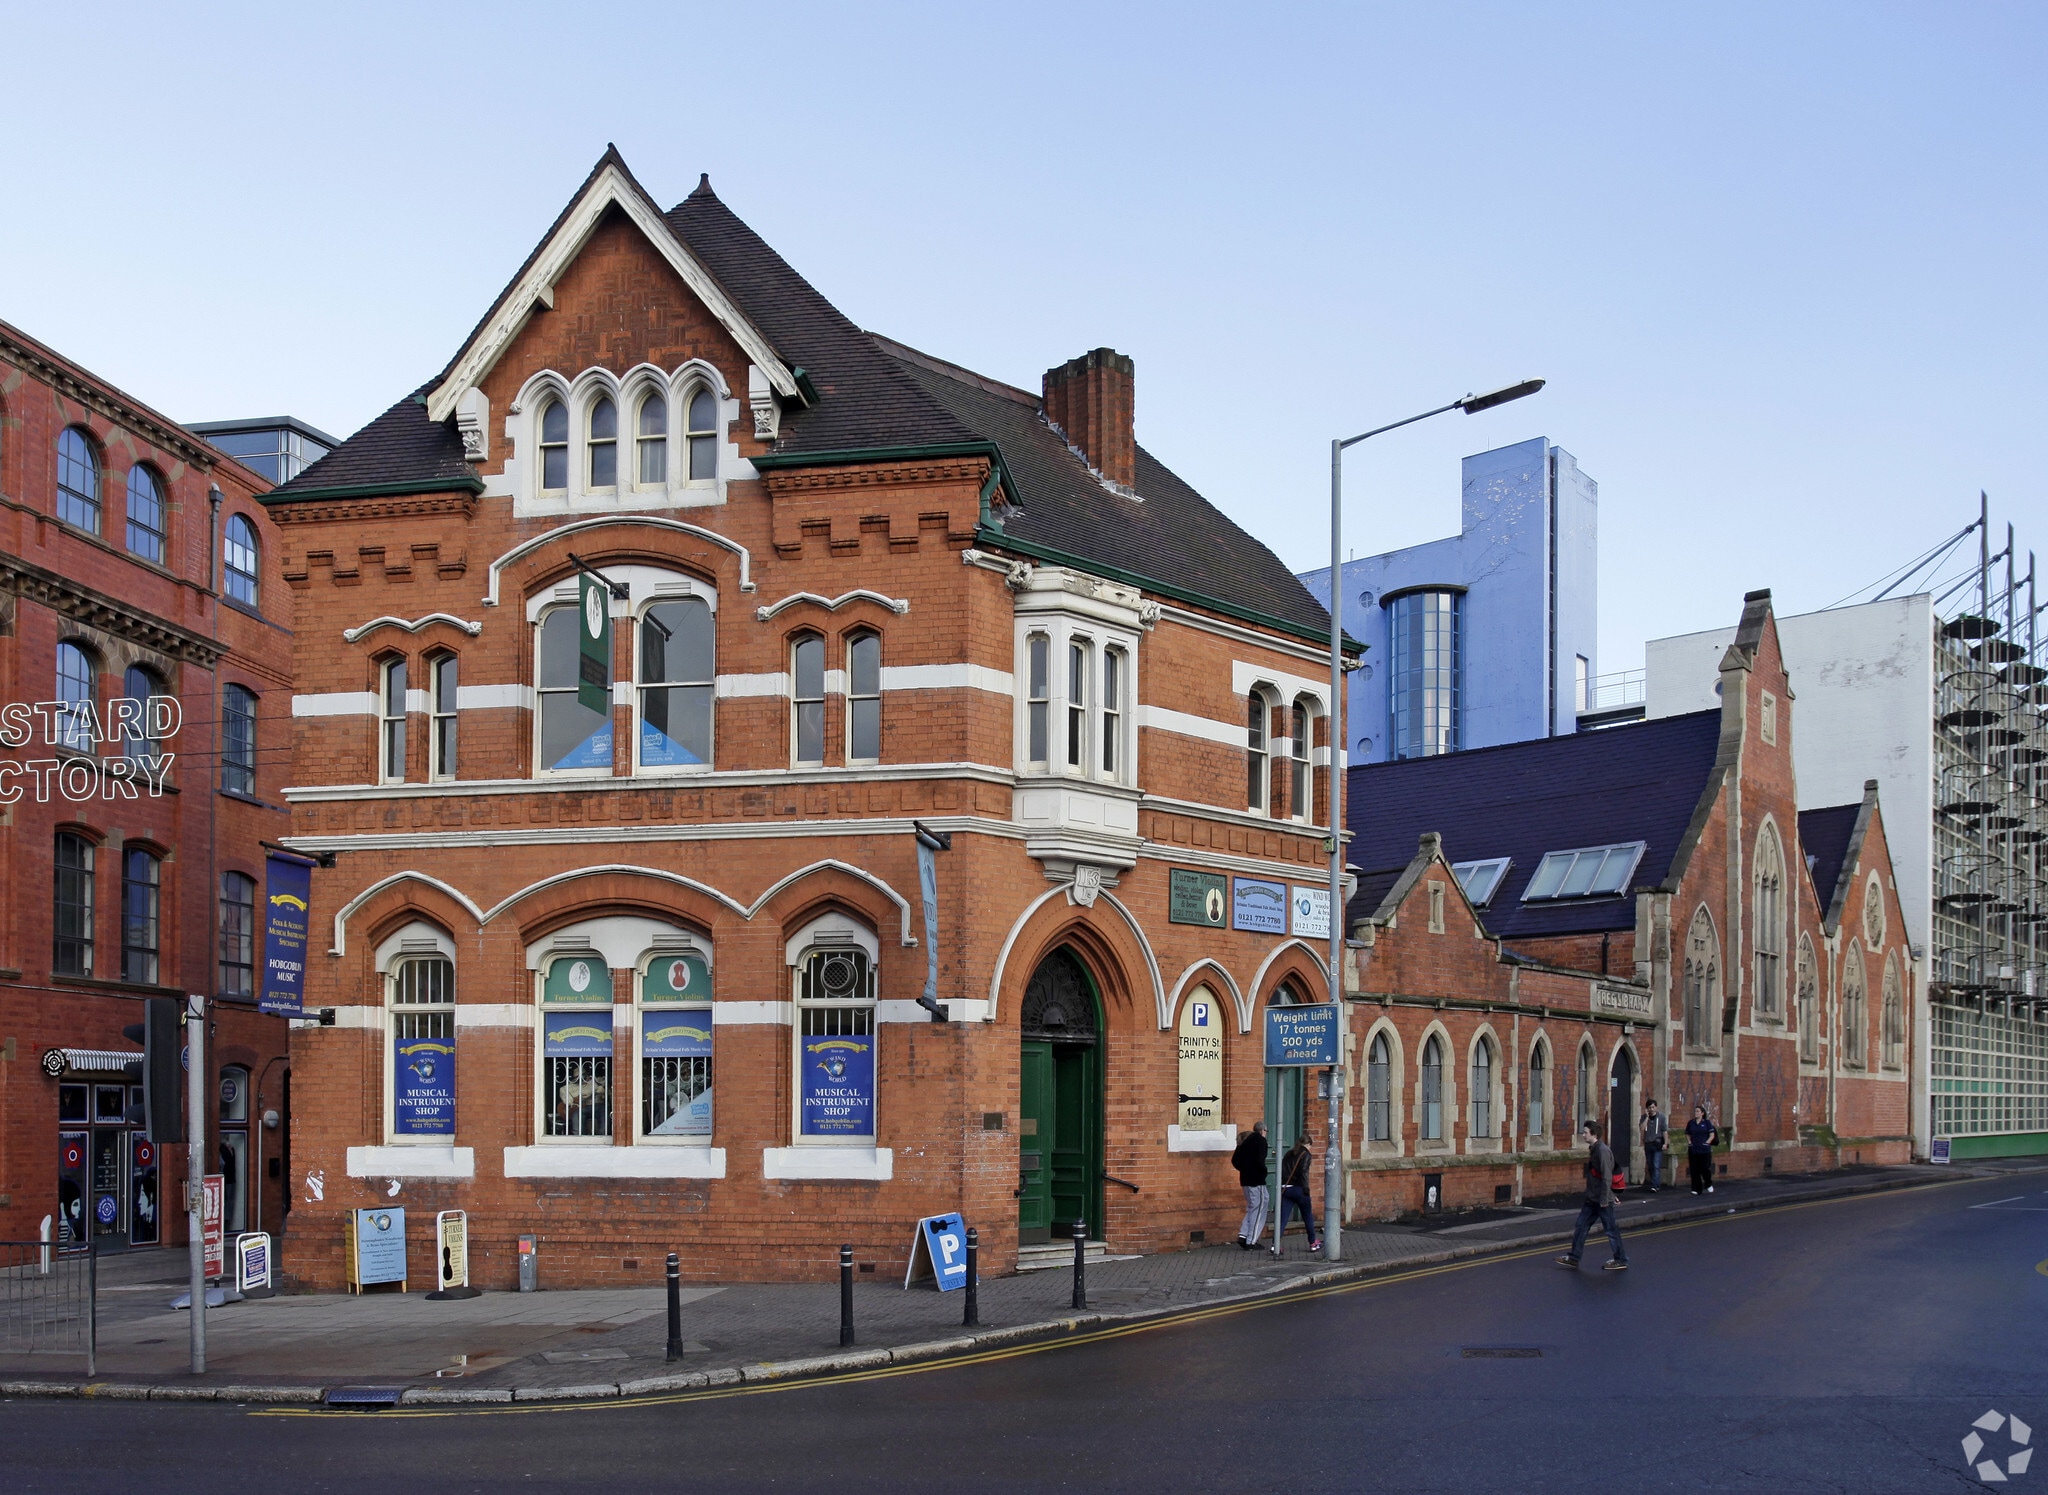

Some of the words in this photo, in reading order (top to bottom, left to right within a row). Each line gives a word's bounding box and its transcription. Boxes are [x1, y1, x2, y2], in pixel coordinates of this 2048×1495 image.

[0, 695, 182, 747] STARD
[0, 753, 175, 804] CTORY
[1174, 871, 1198, 883] Turner
[1200, 874, 1223, 887] Violins
[1238, 913, 1253, 922] 0121
[1255, 915, 1266, 923] 772
[1267, 916, 1281, 925] 7780
[1295, 922, 1309, 930] 0121
[269, 959, 302, 972] HOBGOBLIN
[277, 972, 296, 982] MUSIC
[680, 993, 704, 1001] Violins
[1194, 1004, 1206, 1025] P
[1272, 1011, 1308, 1023] Weight
[1311, 1010, 1333, 1021] limit
[1280, 1025, 1289, 1035] 17
[1294, 1024, 1326, 1034] tonnes
[1178, 1036, 1210, 1047] TRINITY
[1212, 1037, 1221, 1048] St.
[1282, 1036, 1303, 1047] 500
[1306, 1036, 1323, 1048] yds
[1178, 1049, 1196, 1060] CAR
[1198, 1050, 1219, 1060] PARK
[1286, 1049, 1317, 1059] ahead
[828, 1075, 847, 1083] WORLD
[407, 1088, 448, 1097] MUSICAL
[815, 1088, 860, 1097] MUSICAL
[399, 1098, 455, 1106] INSTRUMENT
[805, 1097, 870, 1106] INSTRUMENT
[415, 1107, 440, 1115] SHOP
[823, 1107, 850, 1116] SHOP
[1187, 1106, 1211, 1117] 100m
[813, 1118, 862, 1126] www.hobgoblin.com
[939, 1234, 960, 1264] P
